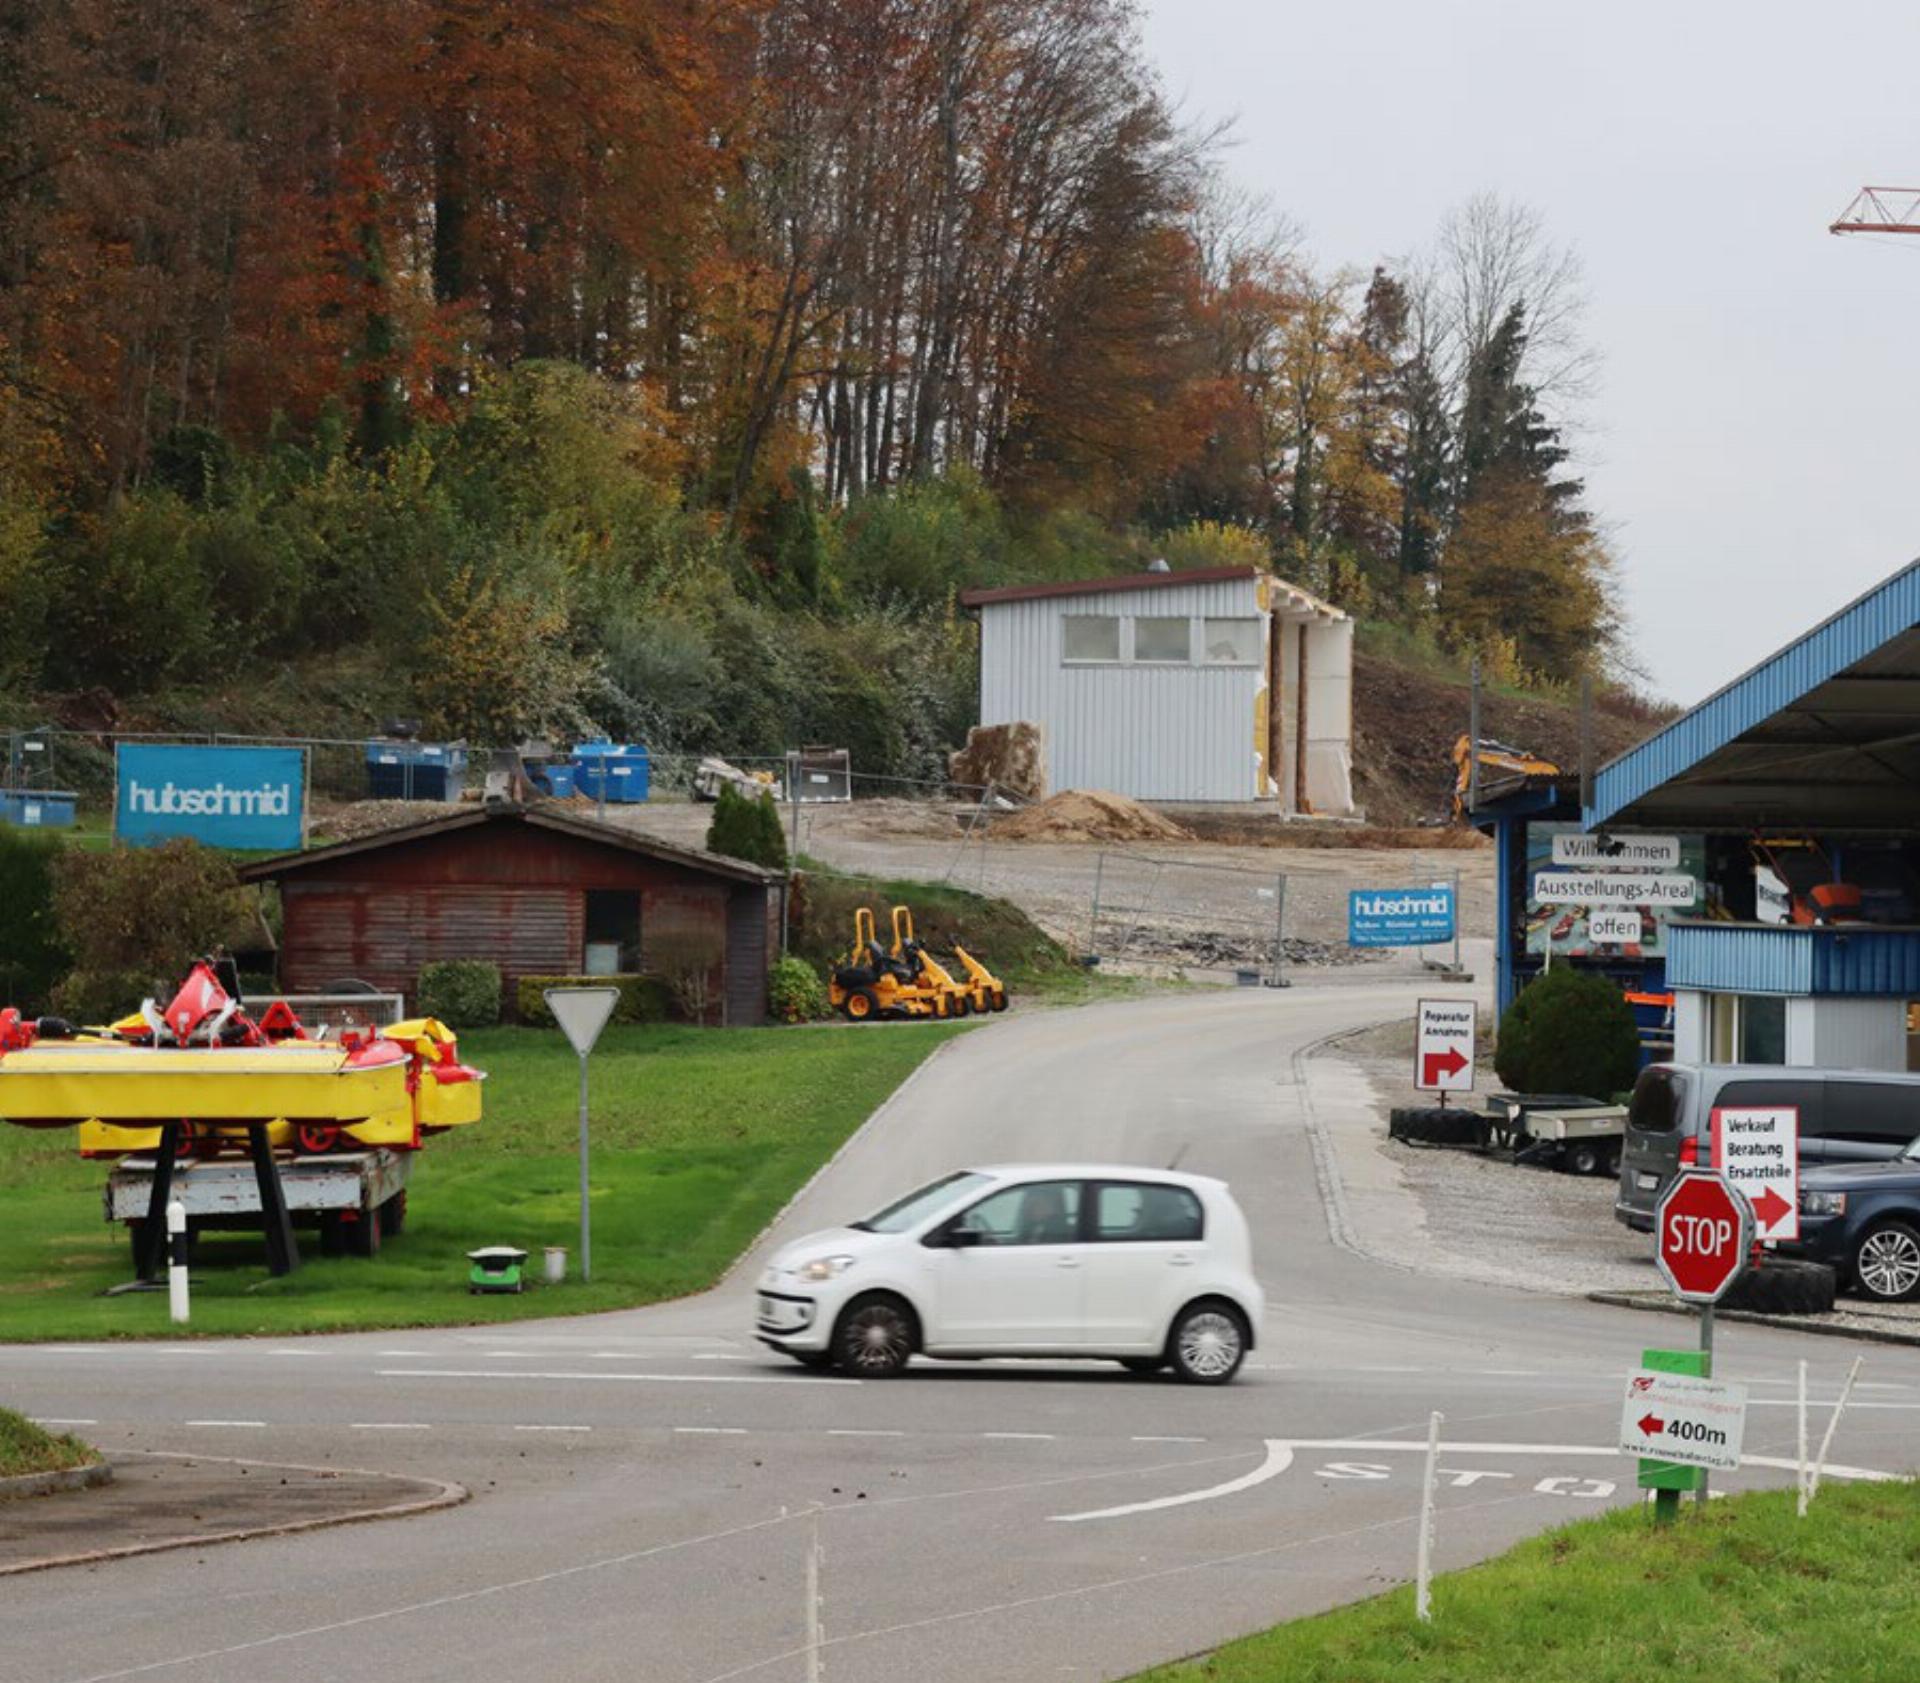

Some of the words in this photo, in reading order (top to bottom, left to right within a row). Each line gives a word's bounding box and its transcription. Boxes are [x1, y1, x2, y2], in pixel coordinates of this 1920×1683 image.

[129, 780, 289, 816] hubschmid
[1536, 879, 1694, 900] Ausstellungs-Areal
[1355, 895, 1447, 915] hubschmid
[1592, 920, 1637, 935] offen
[1727, 1116, 1776, 1133] Verkauf
[1727, 1142, 1784, 1159] Beratung
[1728, 1163, 1792, 1179] Ersatzteile
[1669, 1214, 1732, 1257] STOP
[1667, 1420, 1726, 1445] 400m
